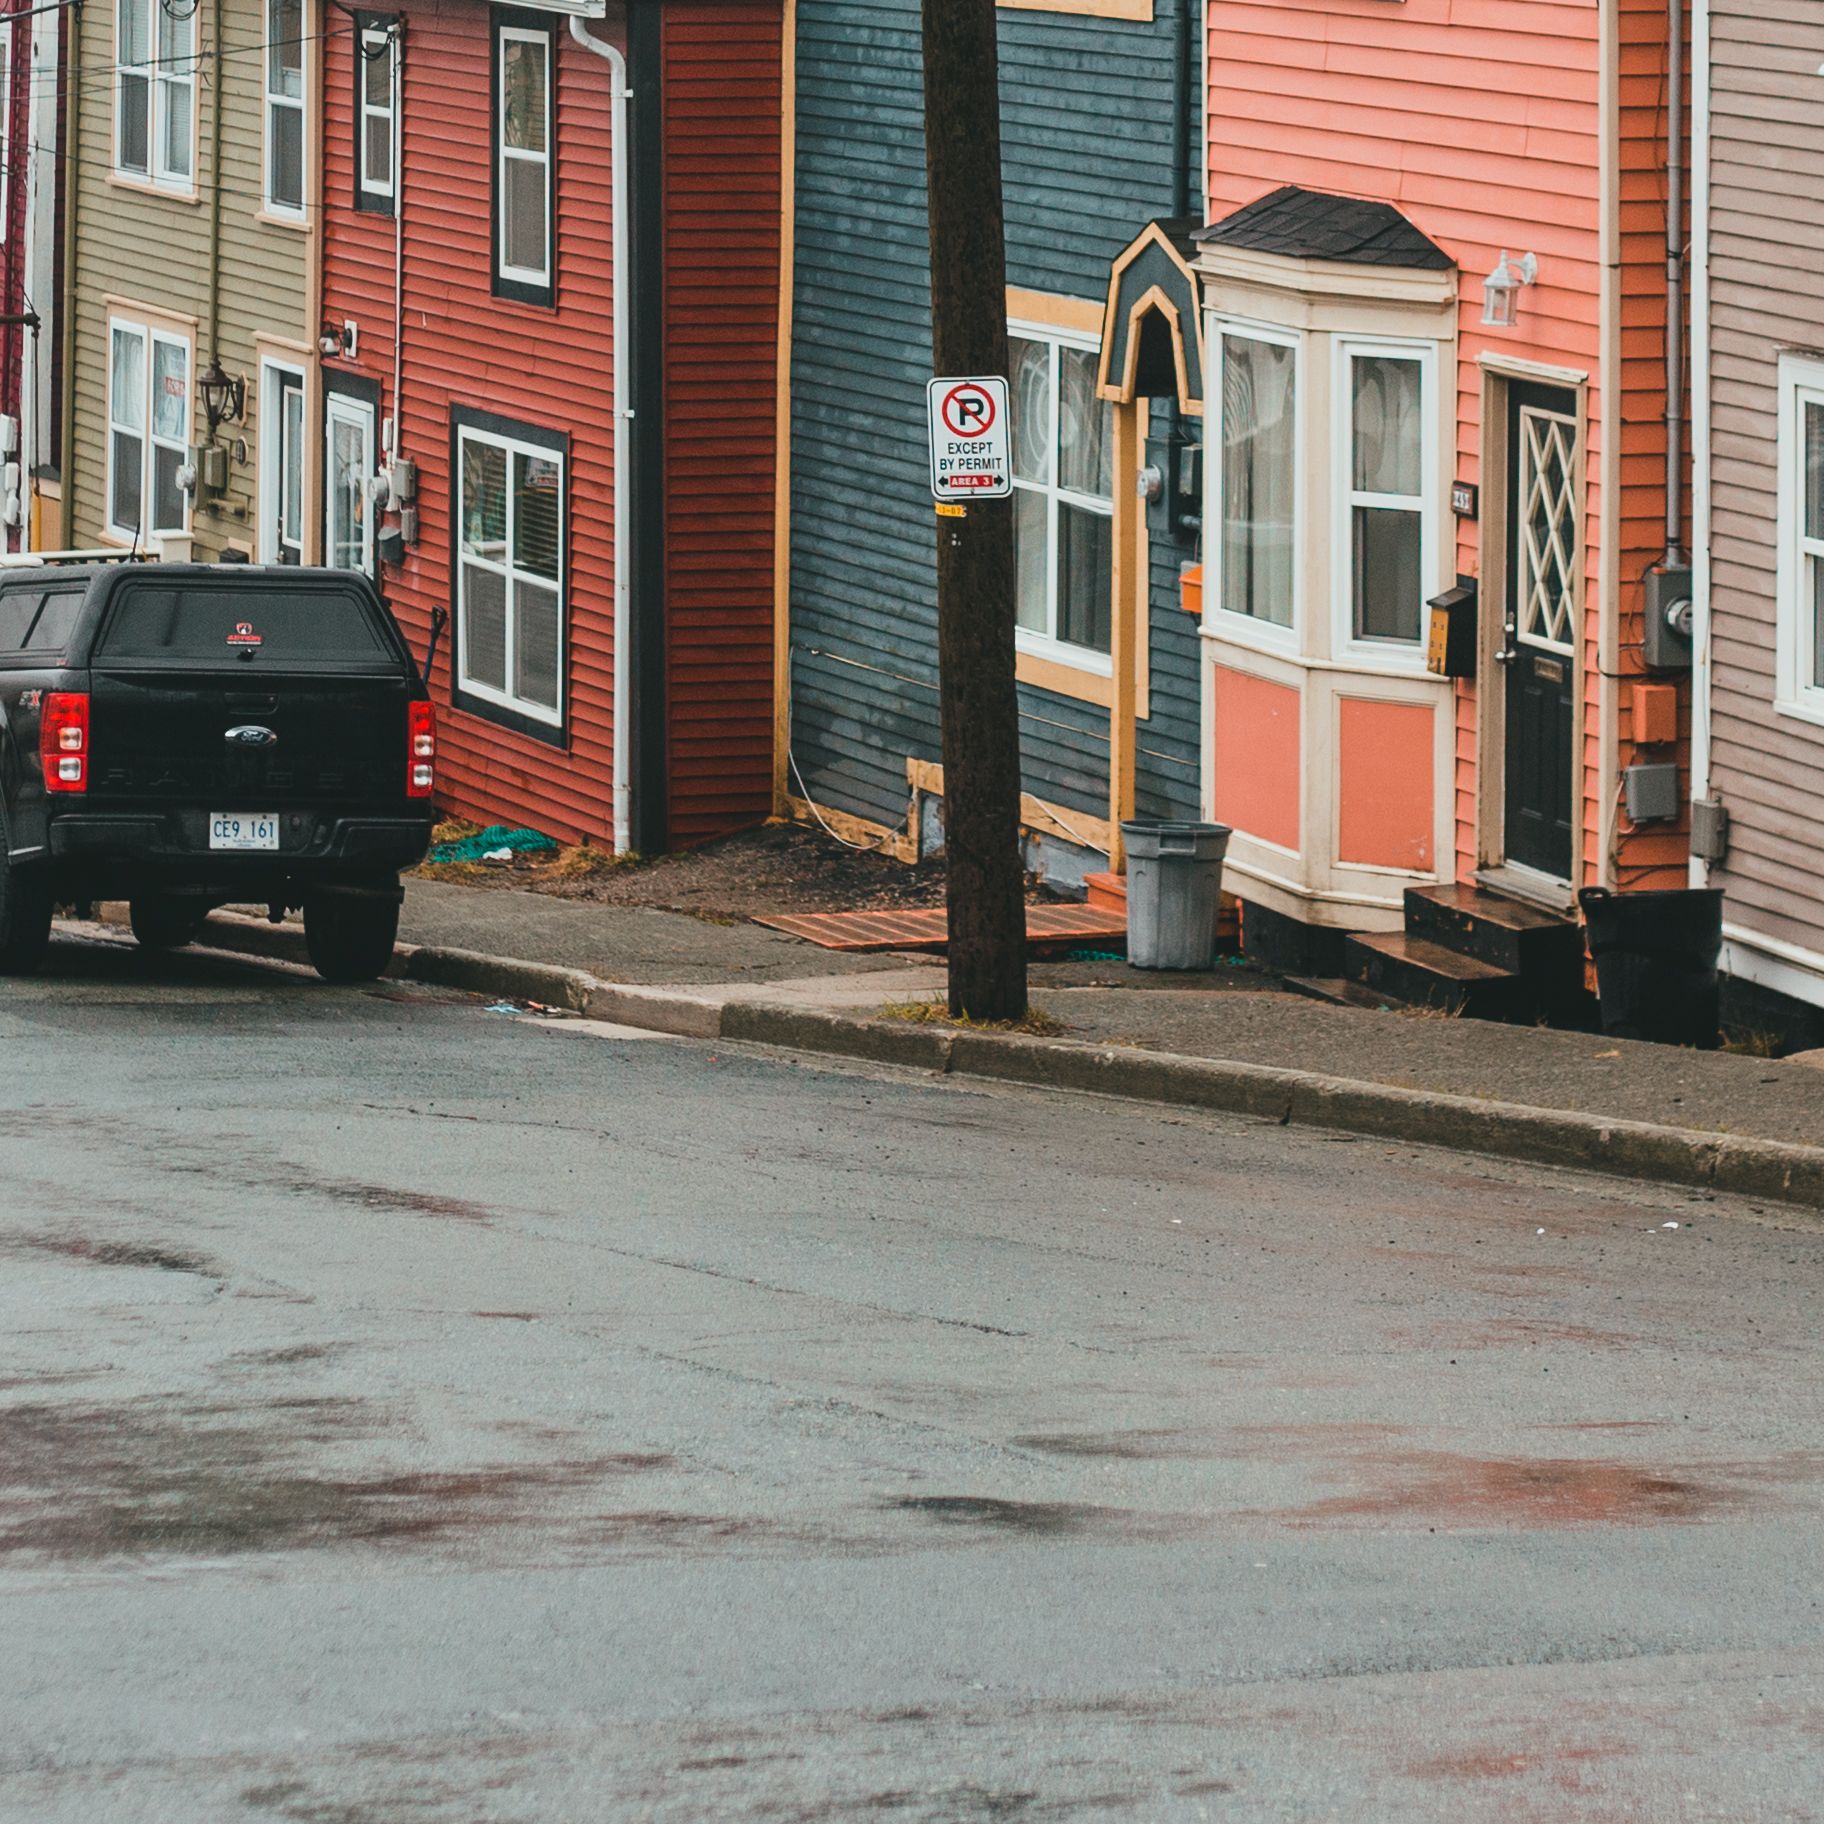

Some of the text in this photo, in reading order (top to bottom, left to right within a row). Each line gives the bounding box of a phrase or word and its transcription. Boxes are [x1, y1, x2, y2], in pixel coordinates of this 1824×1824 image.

[947, 441, 993, 455] EXCEPT
[939, 457, 1002, 470] BY PERMIT
[951, 478, 990, 486] AREA 3
[240, 729, 265, 742] Ford
[213, 820, 274, 838] CE9 161
